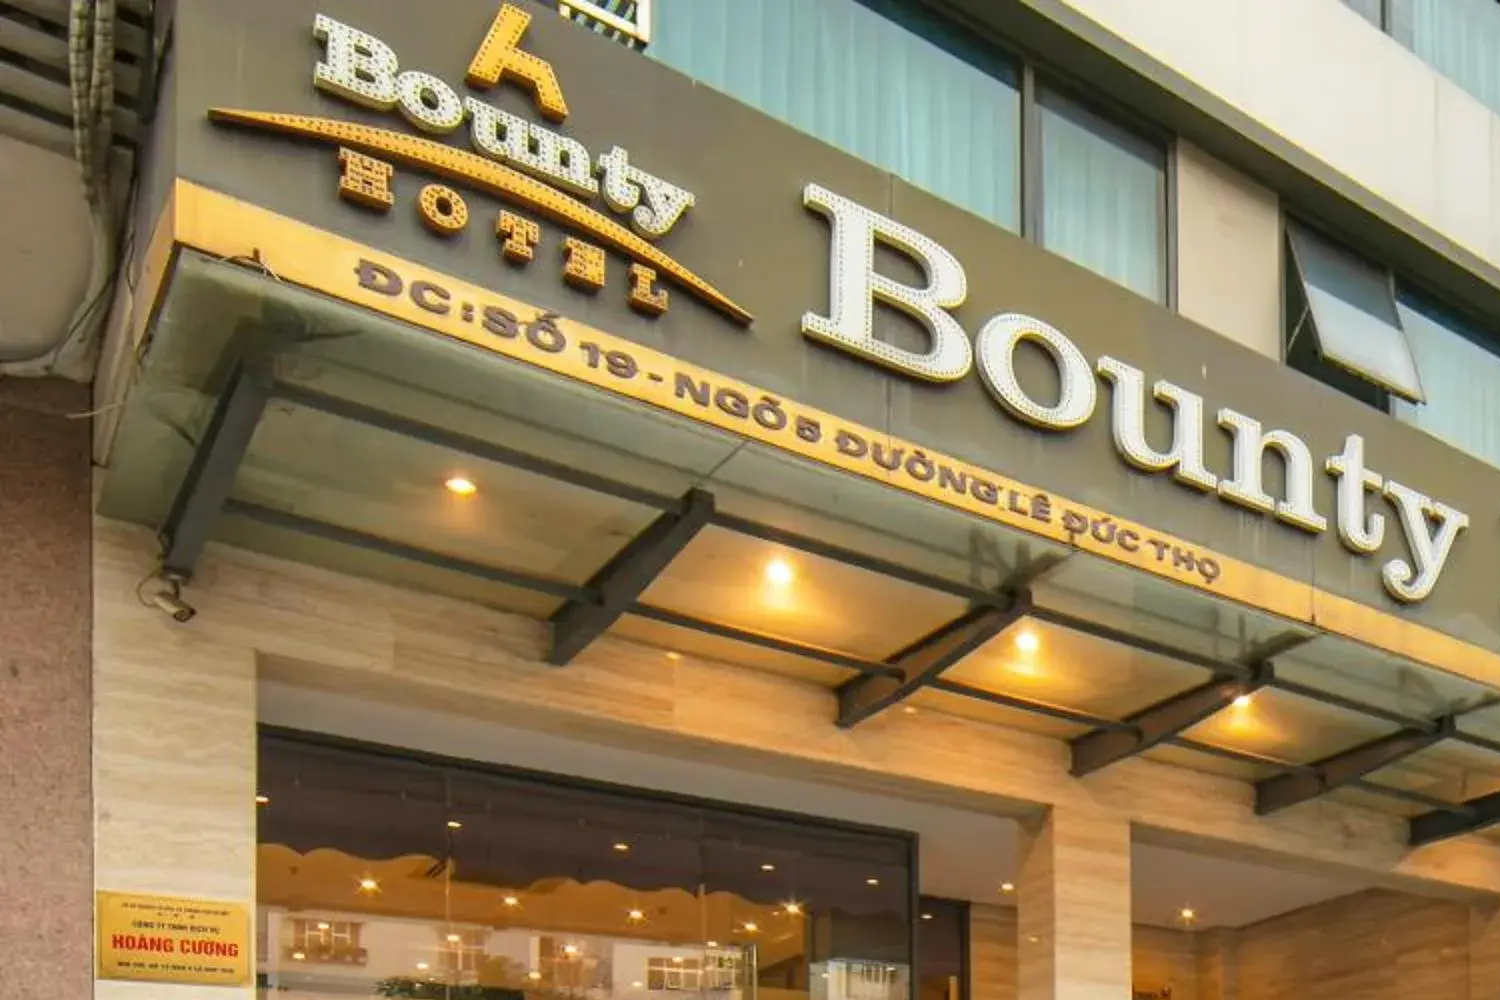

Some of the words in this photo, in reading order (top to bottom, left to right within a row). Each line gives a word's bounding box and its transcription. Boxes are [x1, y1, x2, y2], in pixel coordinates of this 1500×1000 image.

[314, 13, 695, 238] Bounty
[338, 147, 669, 316] HOTEL
[801, 182, 1469, 602] Bounty
